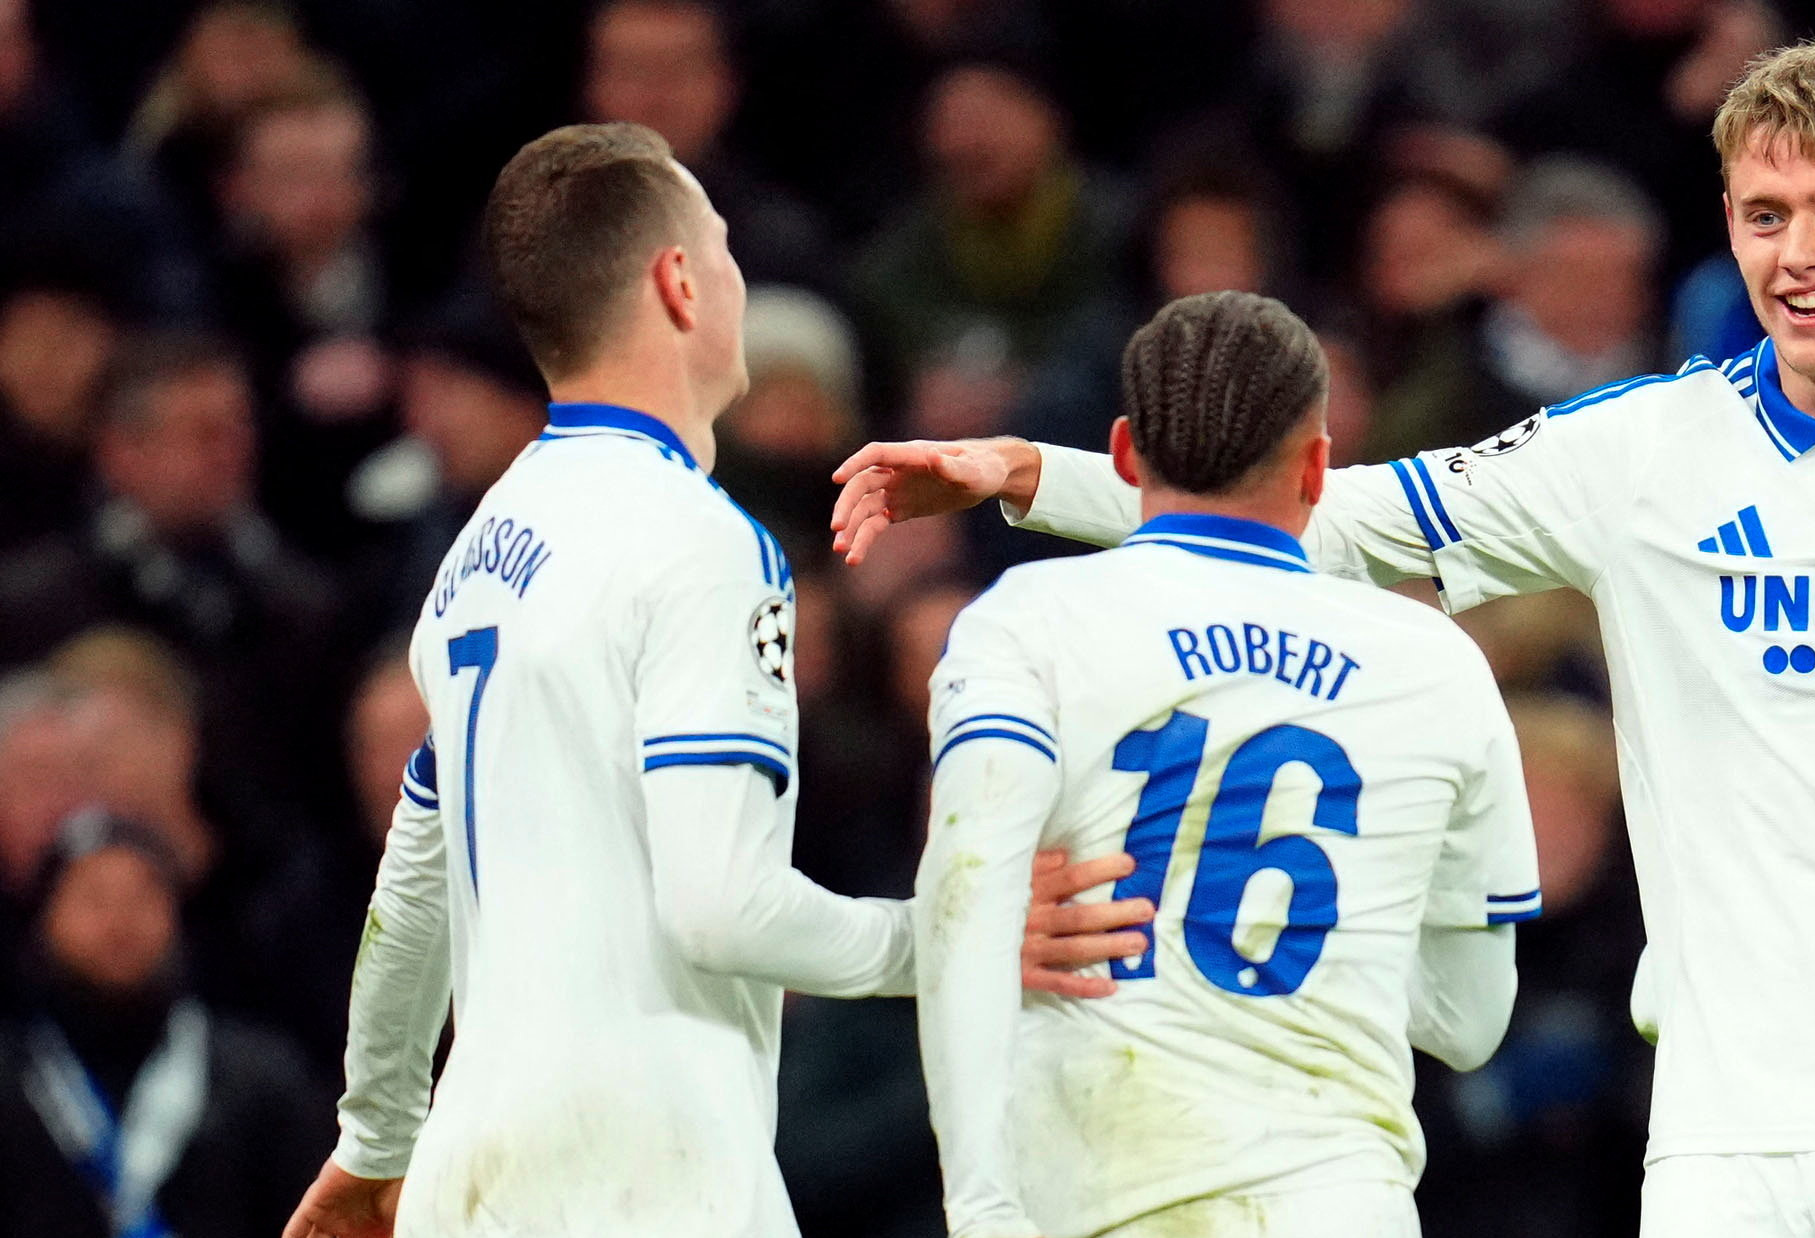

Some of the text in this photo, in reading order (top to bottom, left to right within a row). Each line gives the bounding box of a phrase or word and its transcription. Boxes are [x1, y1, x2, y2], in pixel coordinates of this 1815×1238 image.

[448, 626, 498, 908] 7
[1167, 622, 1361, 702] ROBERT
[1112, 710, 1362, 997] 16
